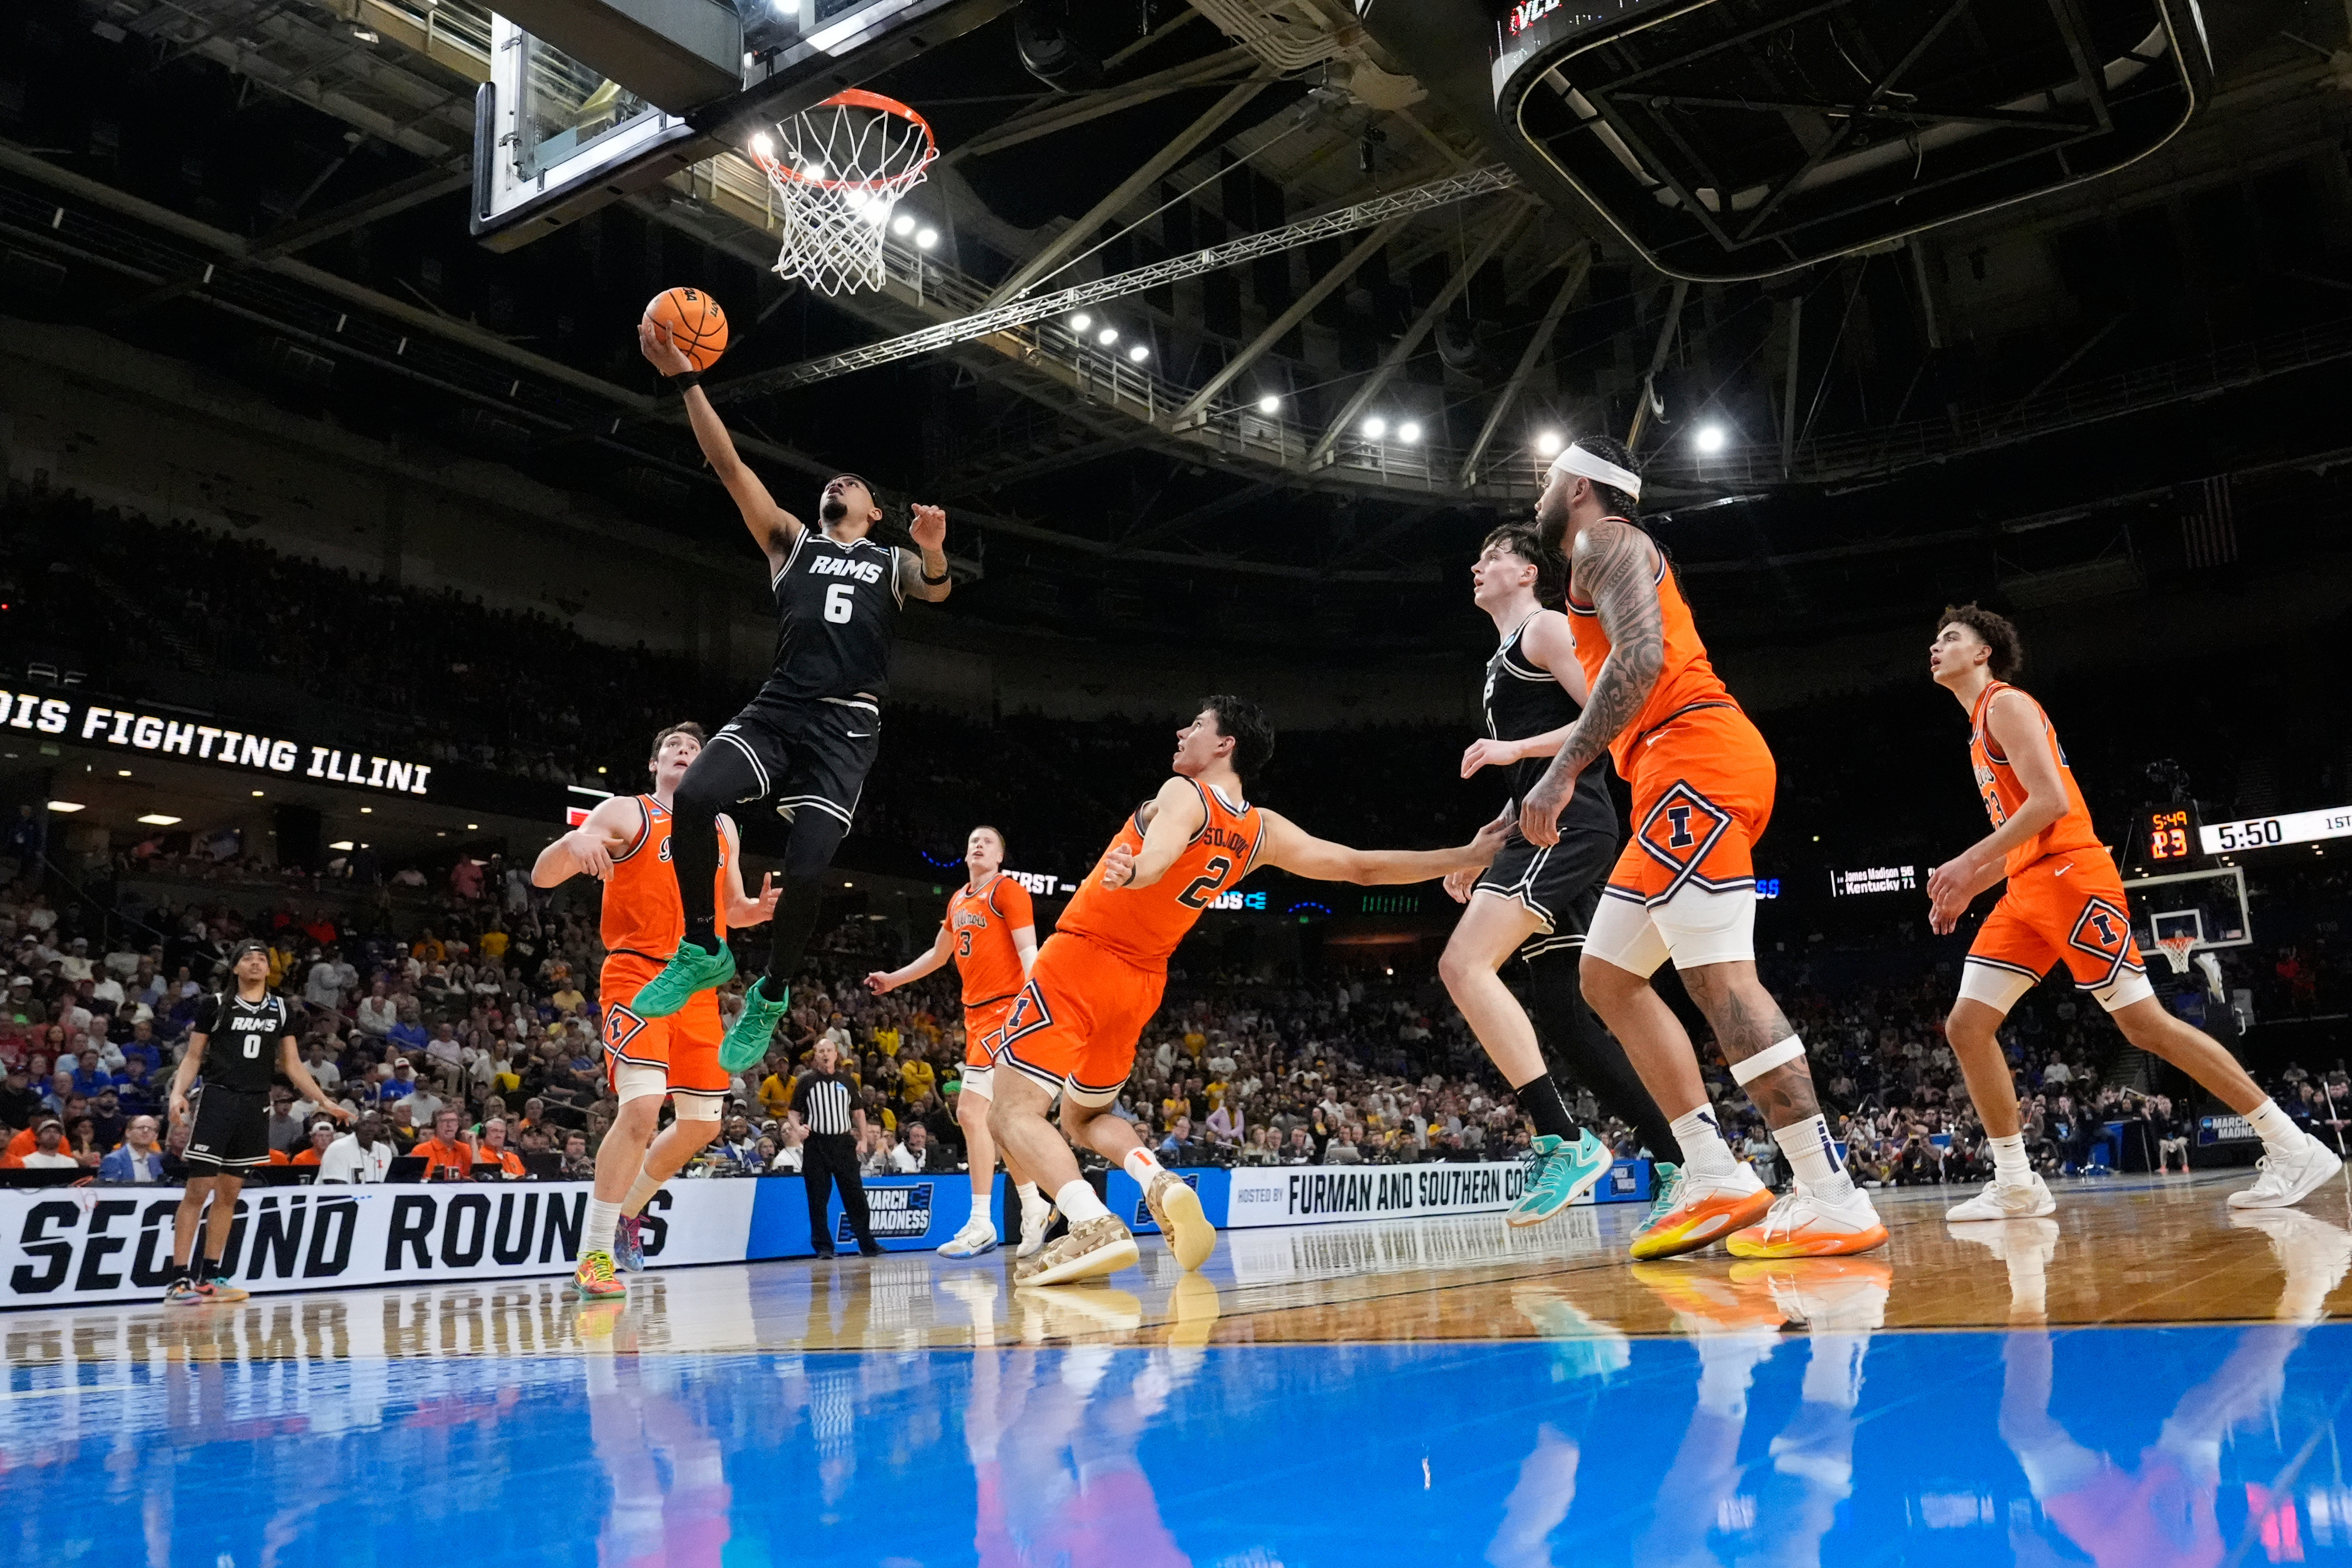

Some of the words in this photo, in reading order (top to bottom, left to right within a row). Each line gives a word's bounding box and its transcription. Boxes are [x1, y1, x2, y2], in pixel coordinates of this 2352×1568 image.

[809, 555, 883, 584] RAMS
[824, 583, 855, 624] 6
[81, 706, 298, 772] FIGHTING
[306, 746, 431, 795] ILLINI
[2153, 811, 2188, 831] 5:49
[2218, 819, 2282, 850] 5:50
[2325, 815, 2352, 829] 1ST
[2152, 828, 2188, 859] 23
[1175, 855, 1232, 910] 2
[1844, 870, 1867, 883] James
[1868, 867, 1899, 880] Madison
[1845, 878, 1900, 895] Kentucky
[1901, 876, 1916, 889] 71
[959, 930, 972, 958] 3
[231, 1016, 277, 1032] RAMS
[243, 1034, 261, 1059] 0
[2218, 1126, 2258, 1139] MADNE
[1238, 1189, 1270, 1203] HOSTED
[1274, 1188, 1284, 1202] BY
[1288, 1174, 1372, 1215] FURMAN
[1377, 1172, 1412, 1210] AND
[1419, 1168, 1499, 1207] SOUTHERN
[869, 1209, 929, 1231] MADNESS
[10, 1195, 359, 1294] SECOND
[385, 1189, 673, 1272] ROUNS
